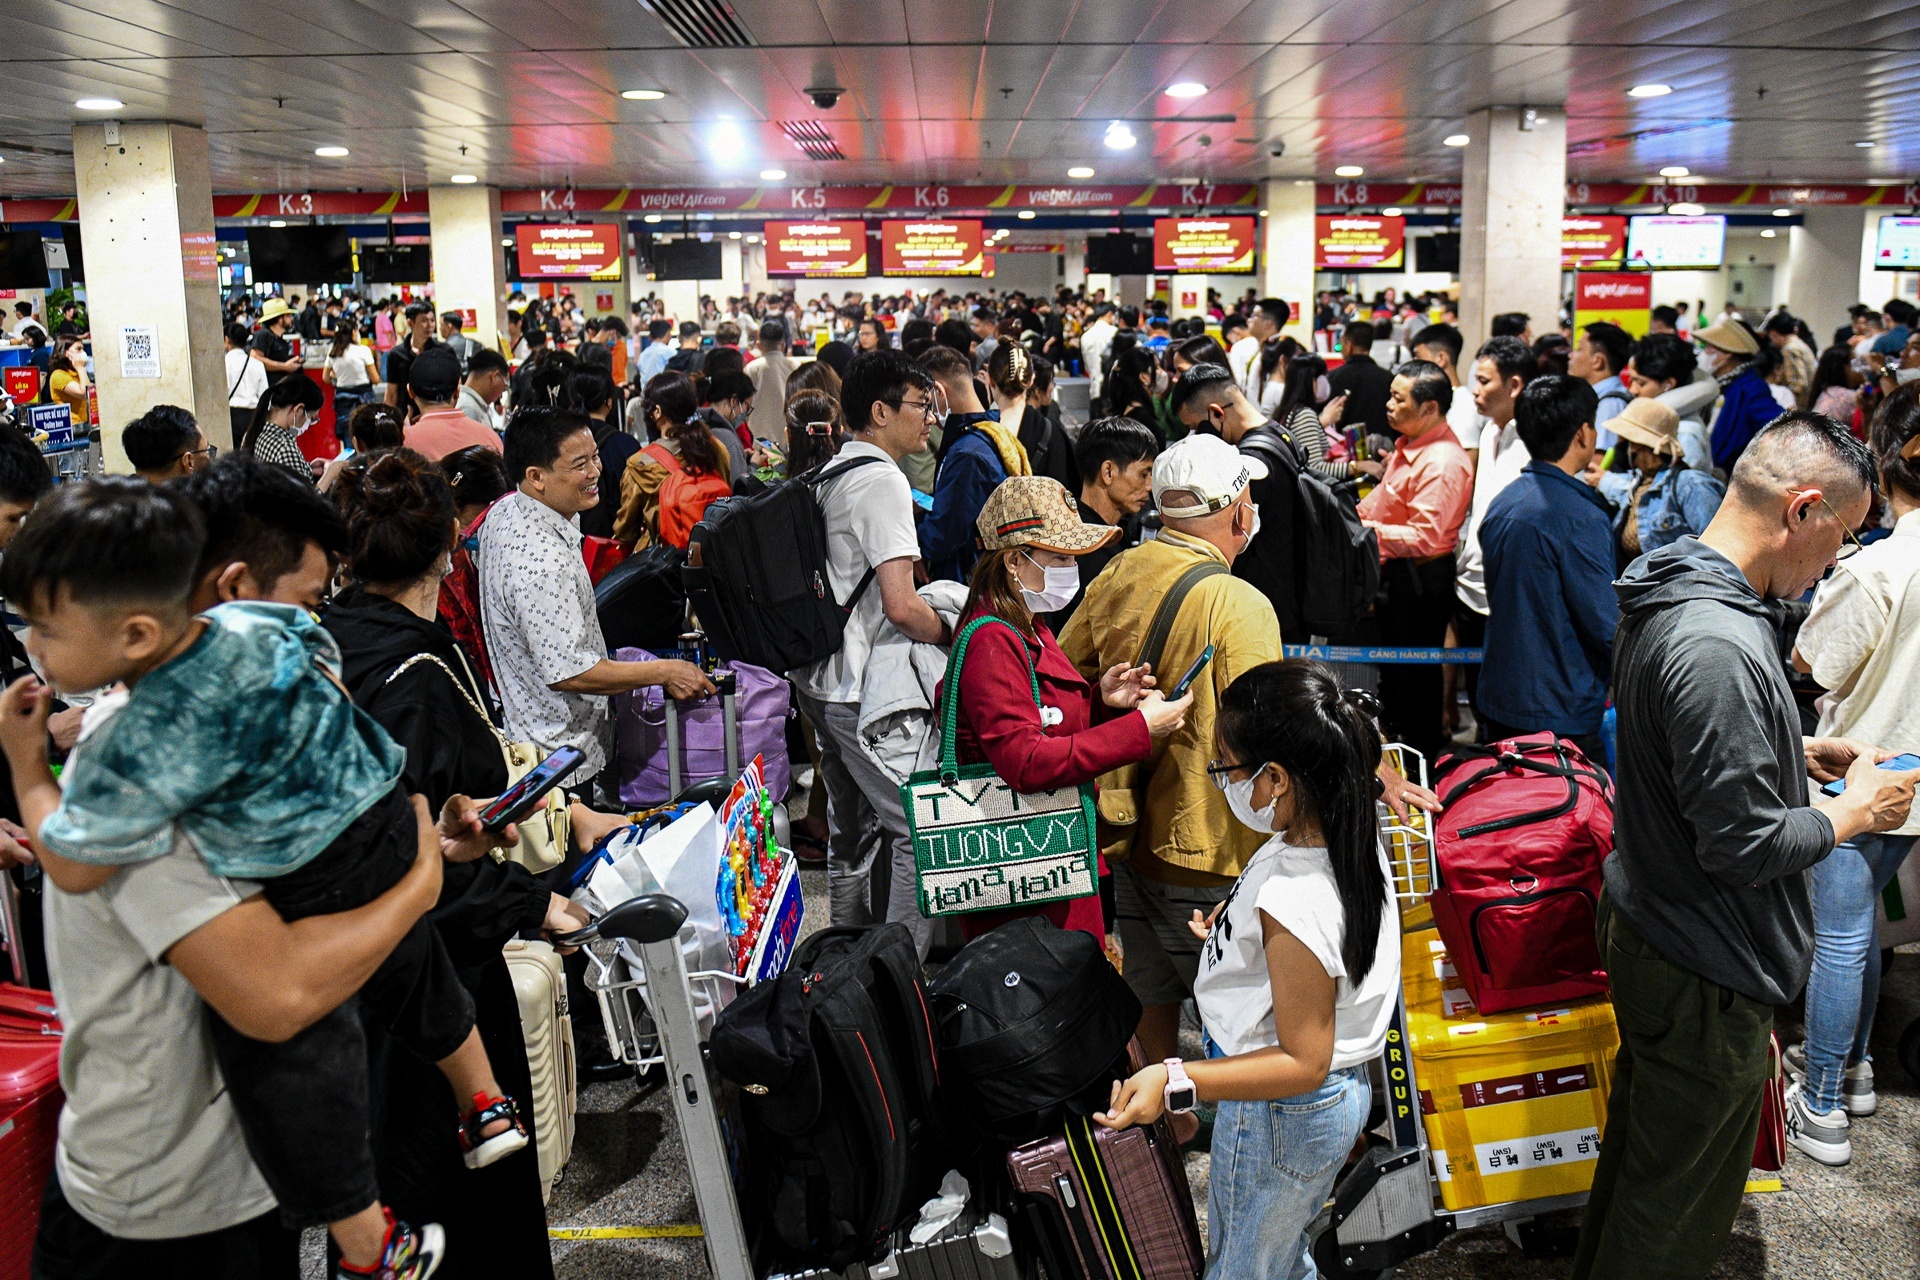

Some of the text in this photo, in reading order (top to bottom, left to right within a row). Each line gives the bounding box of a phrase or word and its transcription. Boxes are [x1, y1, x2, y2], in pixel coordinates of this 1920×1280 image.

[278, 194, 313, 214] K.3
[540, 189, 576, 210] K.4
[790, 188, 826, 208] K.5
[915, 187, 950, 207] K.6
[1181, 185, 1215, 204] K.7
[1334, 184, 1368, 204] K.8
[1652, 185, 1698, 203] K.10
[1285, 644, 1323, 658] TIA
[917, 781, 1055, 821] TVT
[1386, 1029, 1409, 1118] GROUP
